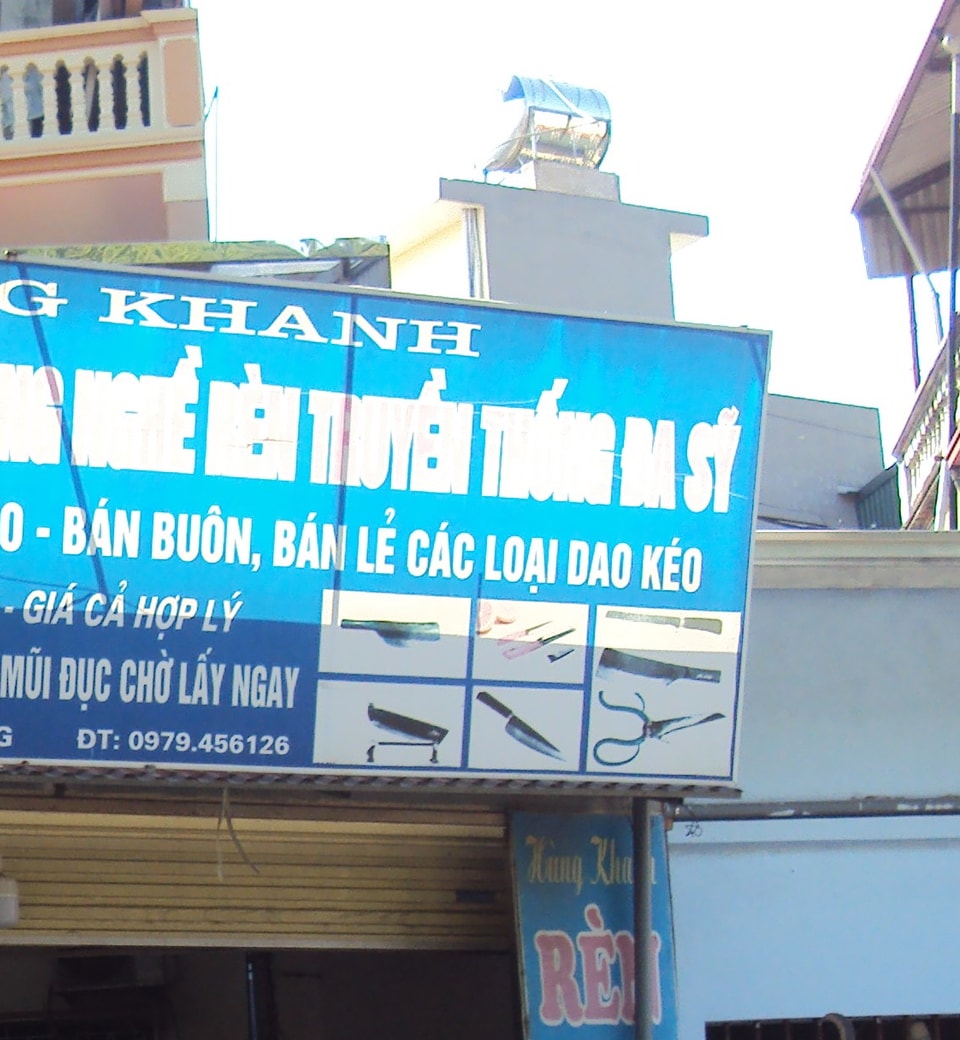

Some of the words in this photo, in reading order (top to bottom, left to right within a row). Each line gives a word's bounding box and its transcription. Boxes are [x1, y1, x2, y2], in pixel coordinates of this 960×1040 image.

[98, 286, 482, 358] KHANH
[308, 368, 474, 496] TRUYỀN
[480, 378, 617, 505] THỐNG
[683, 407, 742, 514] SỸ
[62, 497, 139, 558] BÁN
[151, 505, 262, 573] BUÔN,
[272, 510, 346, 571] BÁN
[357, 506, 395, 574] LẺ
[406, 518, 475, 581] CÁC
[484, 537, 556, 595] LOẠI
[568, 540, 632, 589] DAO
[640, 527, 702, 594] KÉO
[3, 606, 14, 615] -
[22, 582, 79, 626] GIÁ
[85, 579, 128, 629] CẢ
[133, 598, 197, 641] HỢP
[201, 590, 244, 634] LÝ
[0, 647, 51, 700] MŨI
[58, 656, 112, 712] ĐỤC
[119, 648, 175, 704] CHỜ
[178, 646, 223, 707] LẤY
[230, 665, 301, 710] NGAY
[76, 728, 121, 751] ĐT:
[128, 730, 291, 756] 0979.456126
